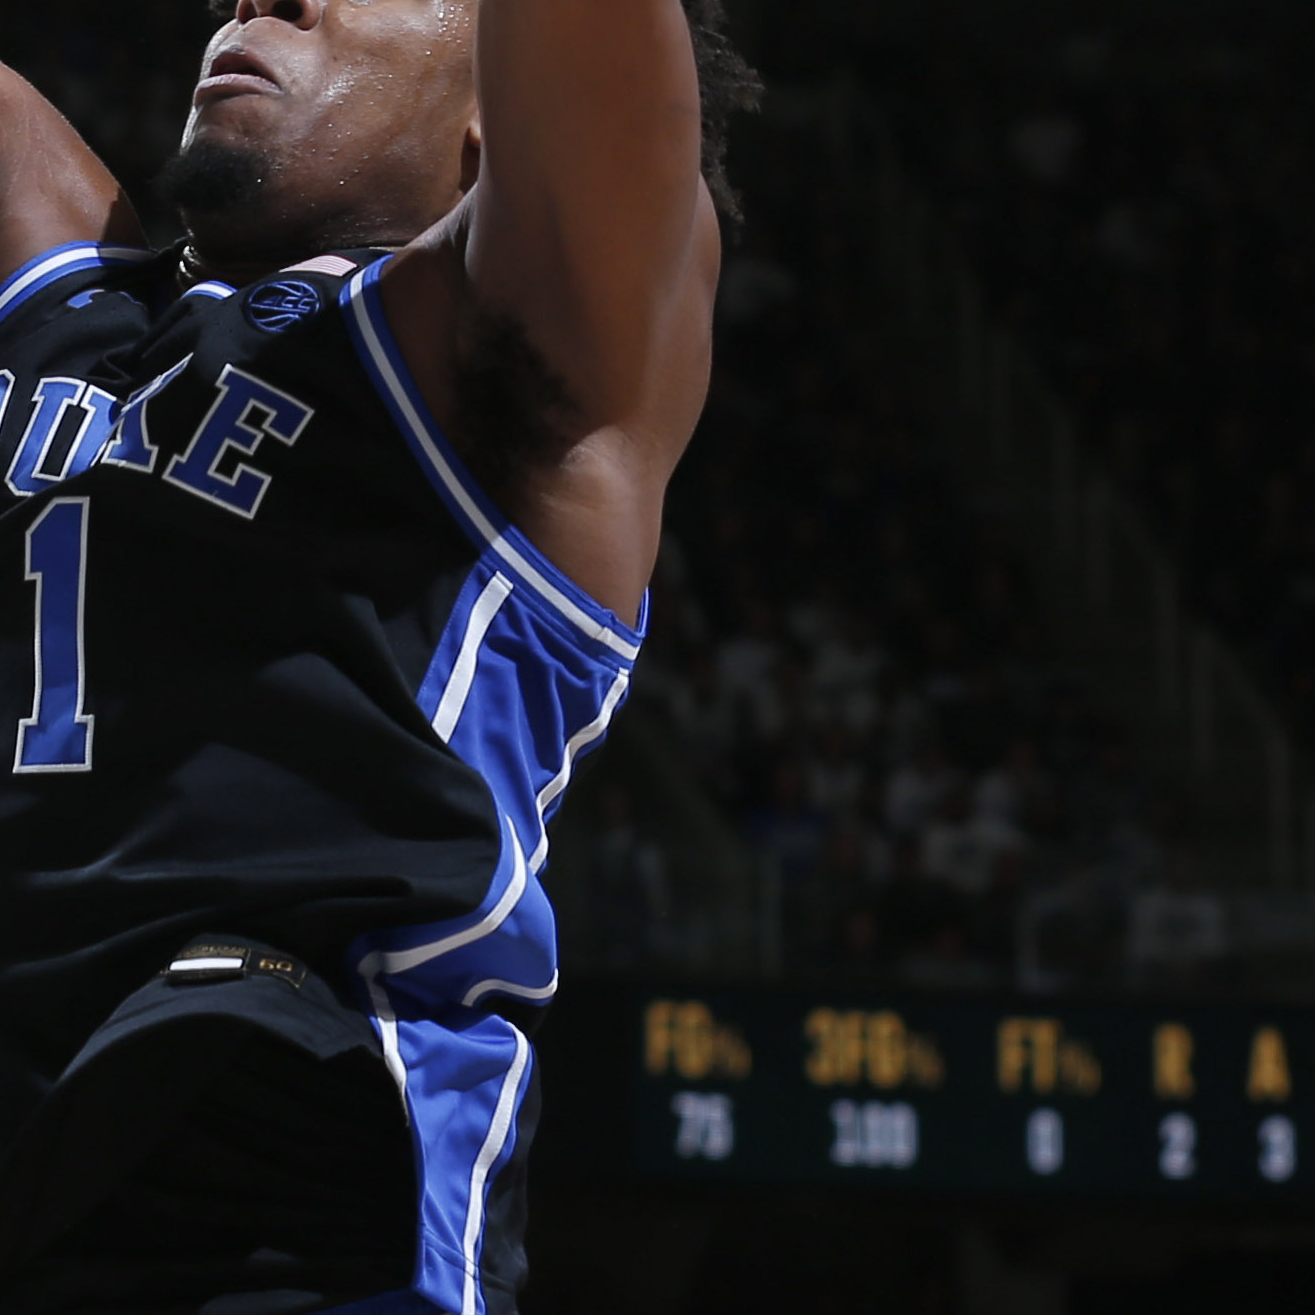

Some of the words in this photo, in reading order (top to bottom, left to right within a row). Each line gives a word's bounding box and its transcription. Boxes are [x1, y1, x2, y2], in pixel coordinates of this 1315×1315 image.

[12, 495, 96, 774] 1
[1152, 1020, 1196, 1102] R
[1246, 1024, 1293, 1103] A
[828, 1096, 920, 1169] 100
[1025, 1105, 1065, 1176] 0
[1157, 1110, 1199, 1181] 2
